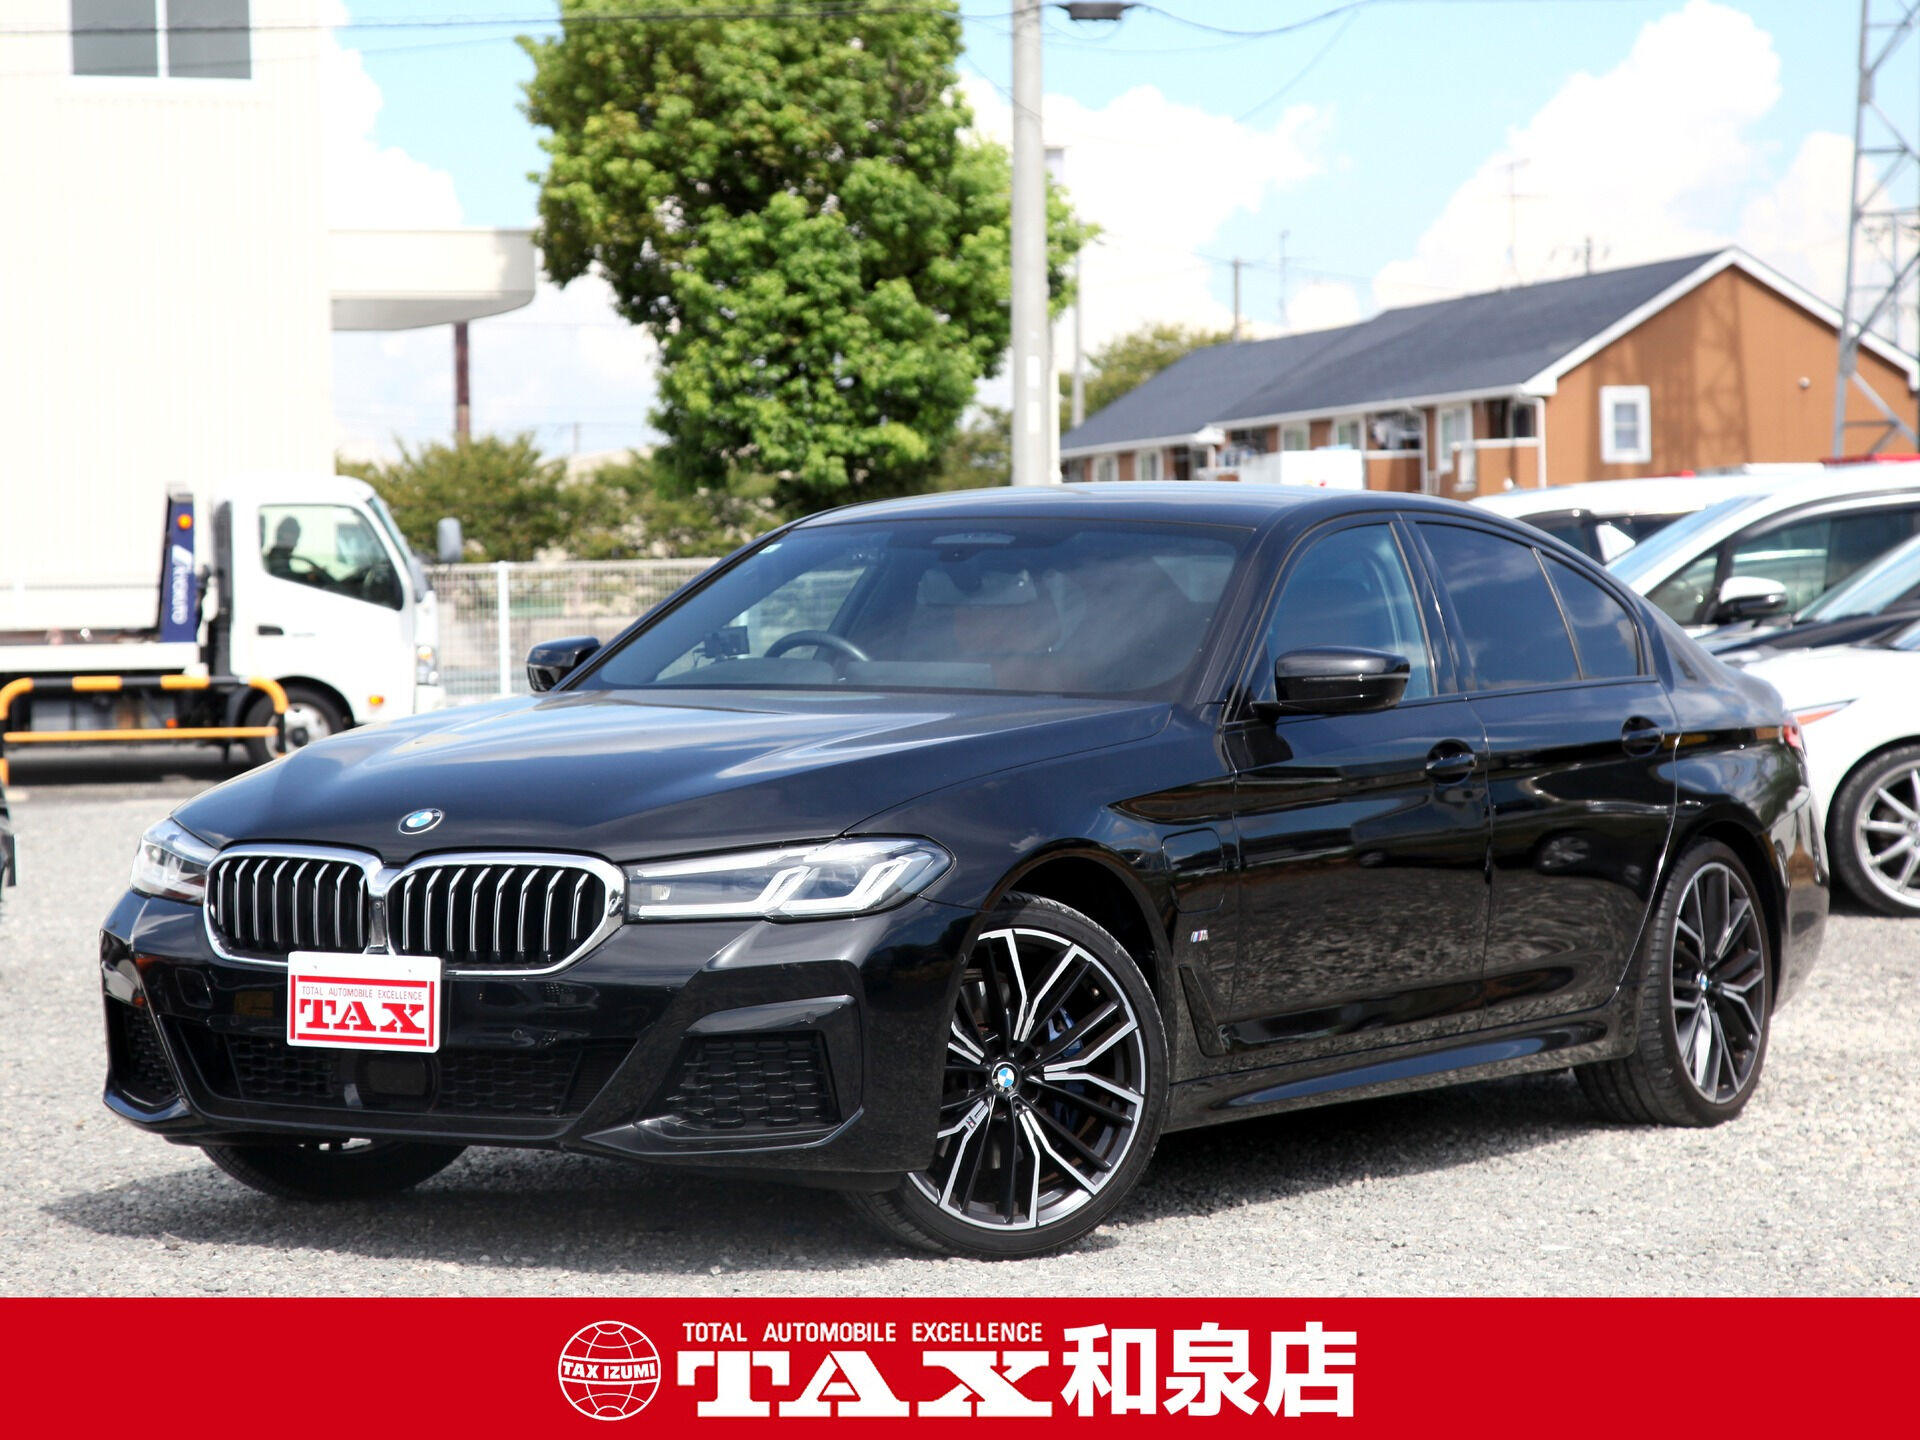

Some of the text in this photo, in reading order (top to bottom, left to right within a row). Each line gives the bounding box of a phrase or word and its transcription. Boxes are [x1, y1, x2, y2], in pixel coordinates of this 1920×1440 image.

[302, 985, 422, 1001] TOTAL AUTOMOBILE EXCELLENCE
[299, 998, 425, 1034] TAX
